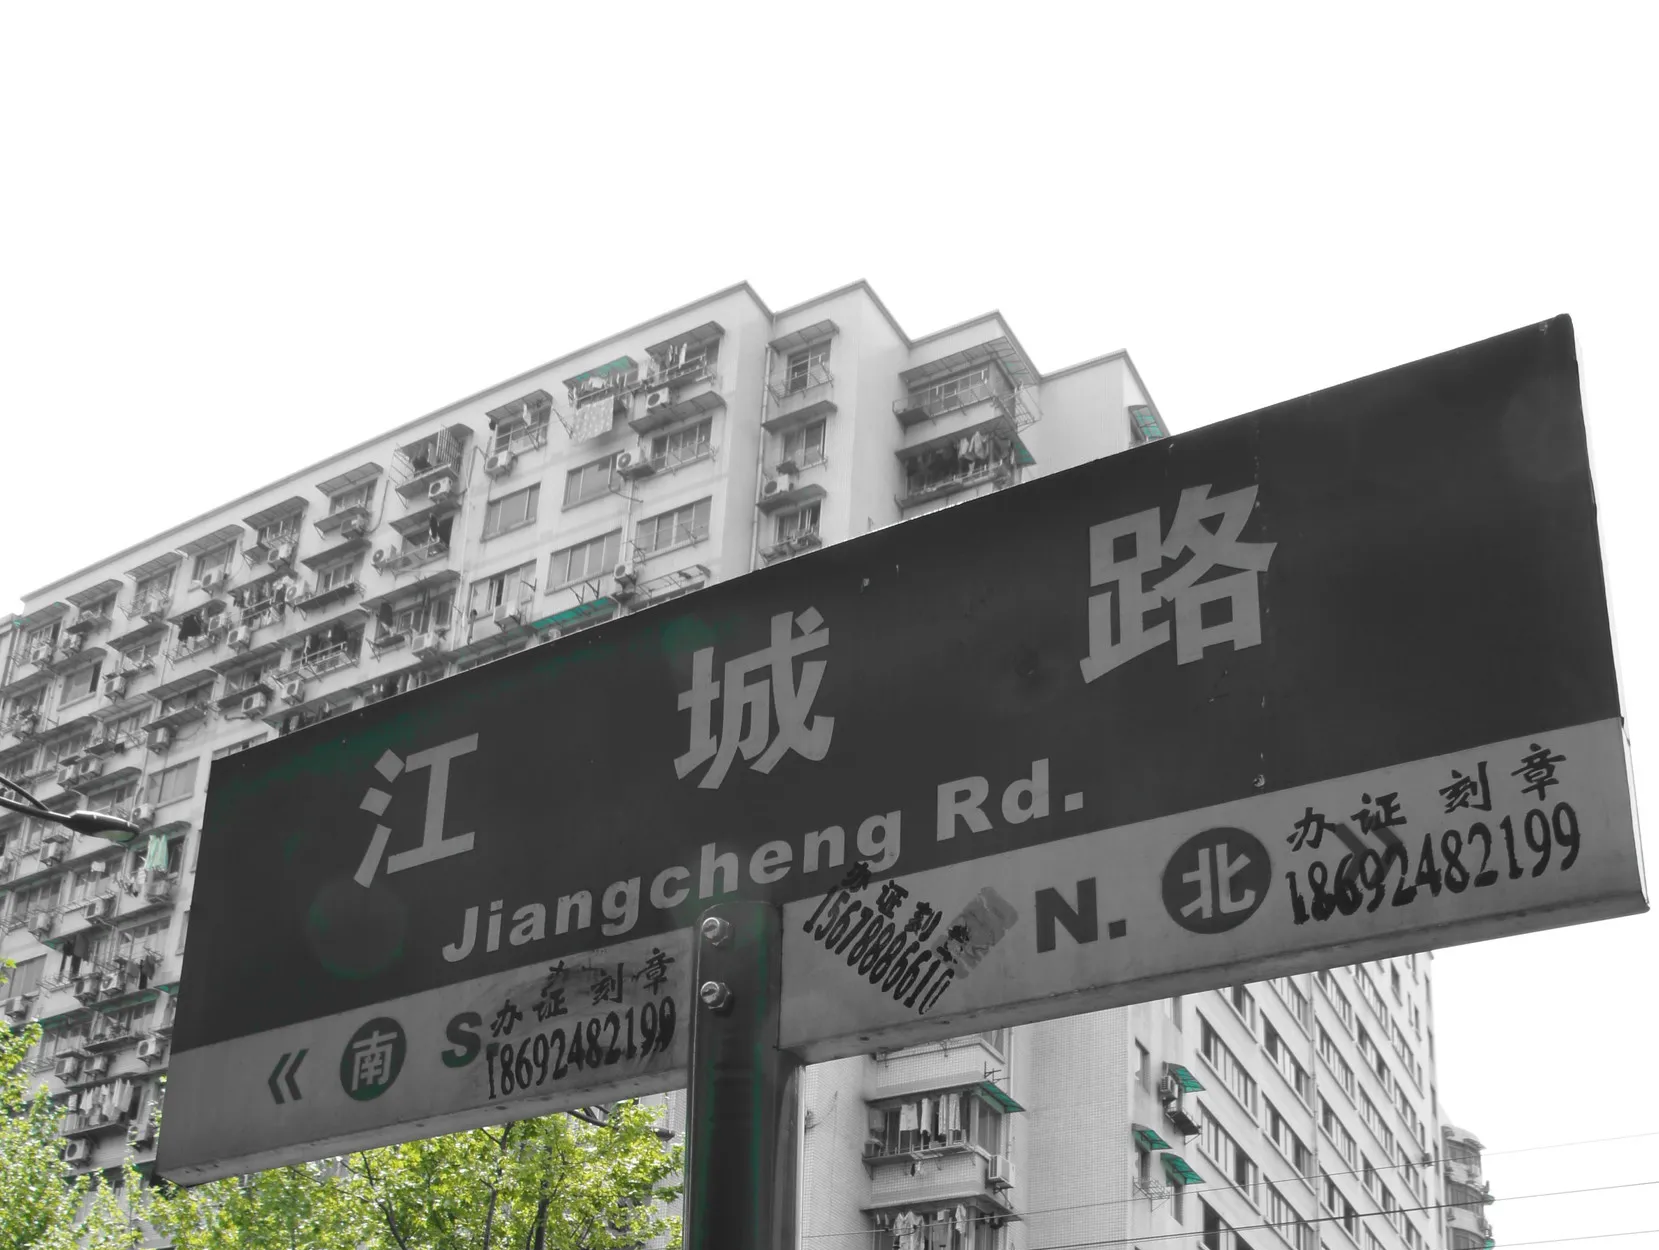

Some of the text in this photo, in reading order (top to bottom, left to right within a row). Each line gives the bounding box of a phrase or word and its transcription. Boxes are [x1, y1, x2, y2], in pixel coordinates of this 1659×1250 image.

[1286, 743, 1567, 852] 办证刻章
[441, 758, 1084, 963] Jiangcheng Rd.
[1034, 842, 1256, 953] N. 北
[1285, 801, 1581, 925] 18692482199
[350, 1029, 399, 1092] 南
